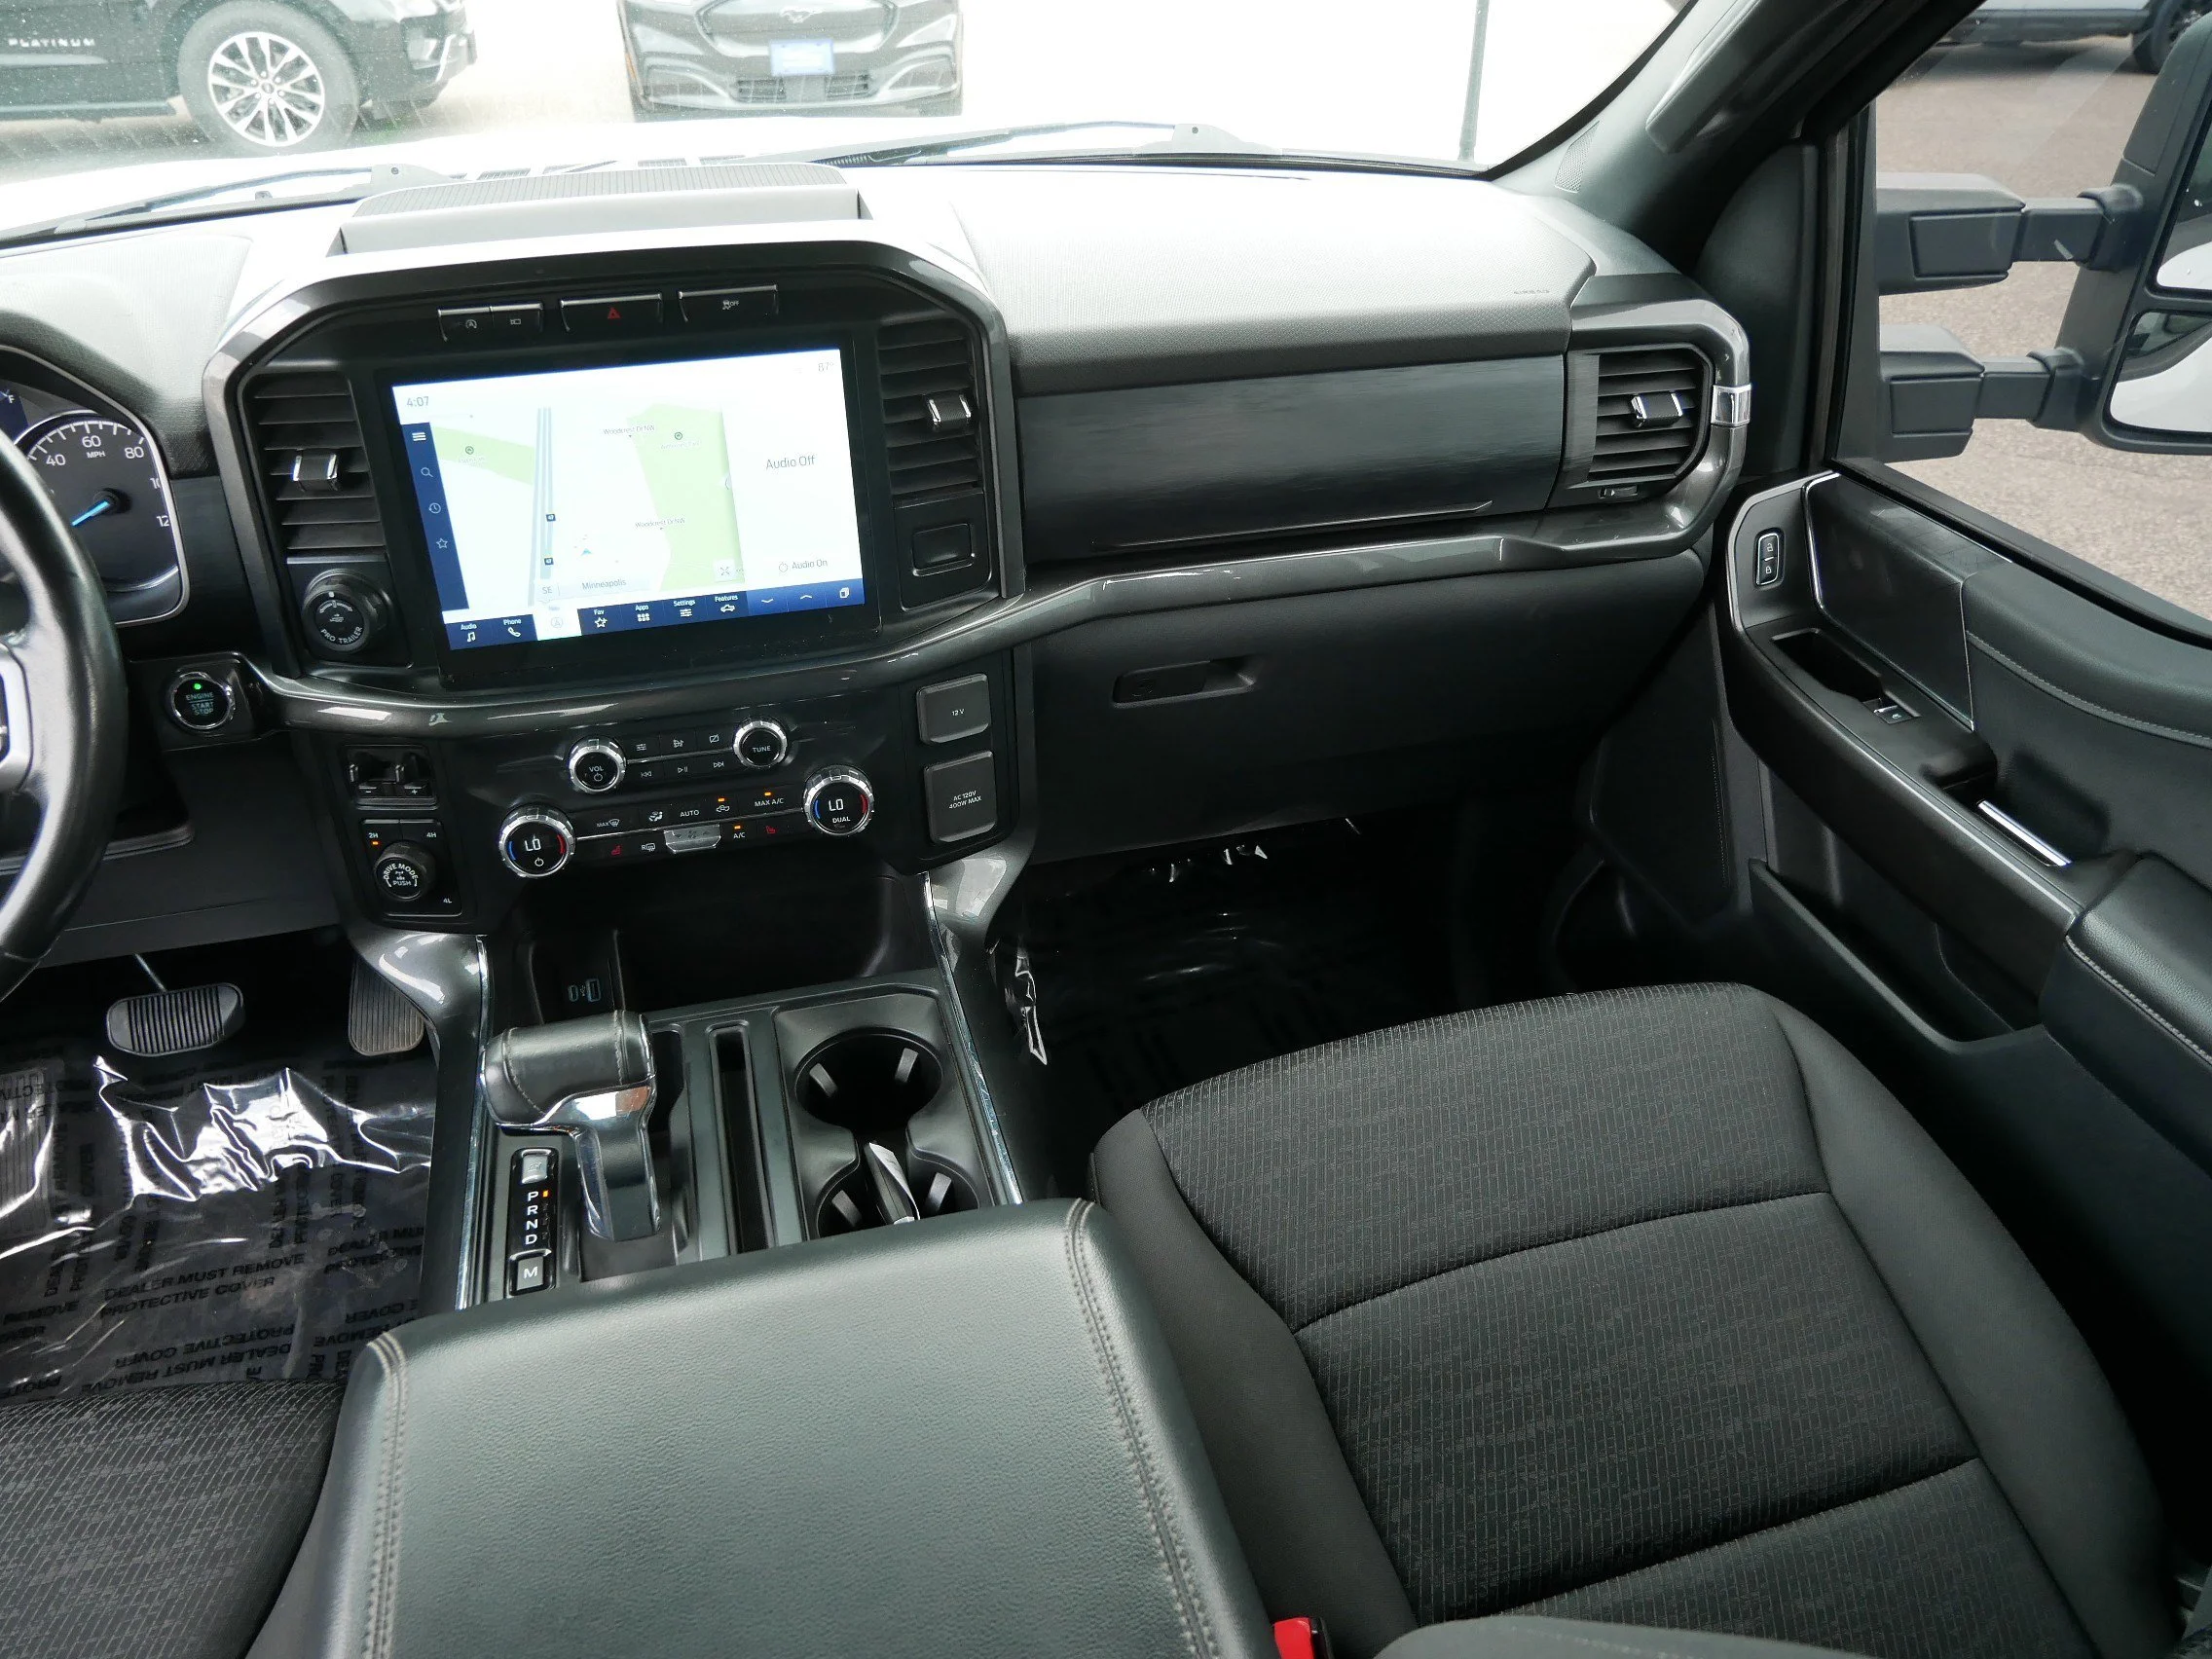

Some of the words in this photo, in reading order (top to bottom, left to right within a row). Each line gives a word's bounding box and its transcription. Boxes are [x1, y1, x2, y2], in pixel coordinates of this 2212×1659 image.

[8, 38, 95, 48] PLATINUM
[8, 394, 16, 404] F
[406, 396, 429, 407] 4:07
[82, 435, 101, 449] 60
[87, 450, 106, 460] MPH
[124, 447, 145, 460] 80
[45, 455, 66, 467] 40
[765, 458, 797, 470] Audio
[798, 454, 816, 467] Off
[792, 561, 815, 571] Audio
[816, 559, 829, 568] On
[581, 579, 627, 590] Minneapolis
[674, 599, 696, 608] Settings
[715, 594, 738, 603] Features
[320, 628, 336, 643] PRO
[338, 626, 363, 645] TRAILER
[185, 691, 215, 701] ENGINE
[191, 701, 214, 711] START
[194, 708, 214, 717] STOP
[962, 790, 977, 799] 120V
[754, 798, 771, 807] MAX
[771, 797, 784, 806] A/C
[948, 799, 968, 810] 400W
[968, 795, 982, 804] MAX
[680, 809, 700, 818] AUTO
[383, 863, 398, 880] DRIVE
[398, 863, 419, 880] MODE
[527, 1191, 539, 1202] P
[527, 1204, 538, 1216] R
[526, 1219, 538, 1231] N
[525, 1234, 538, 1245] D
[104, 1276, 175, 1302] DEALER
[177, 1266, 228, 1284] MUST
[232, 1252, 306, 1275] REMOVE
[523, 1266, 538, 1279] M
[99, 1286, 211, 1319] PROTECTIVE
[214, 1276, 276, 1296] COVER
[221, 1343, 292, 1368] DEALER
[162, 1355, 216, 1379] MUST
